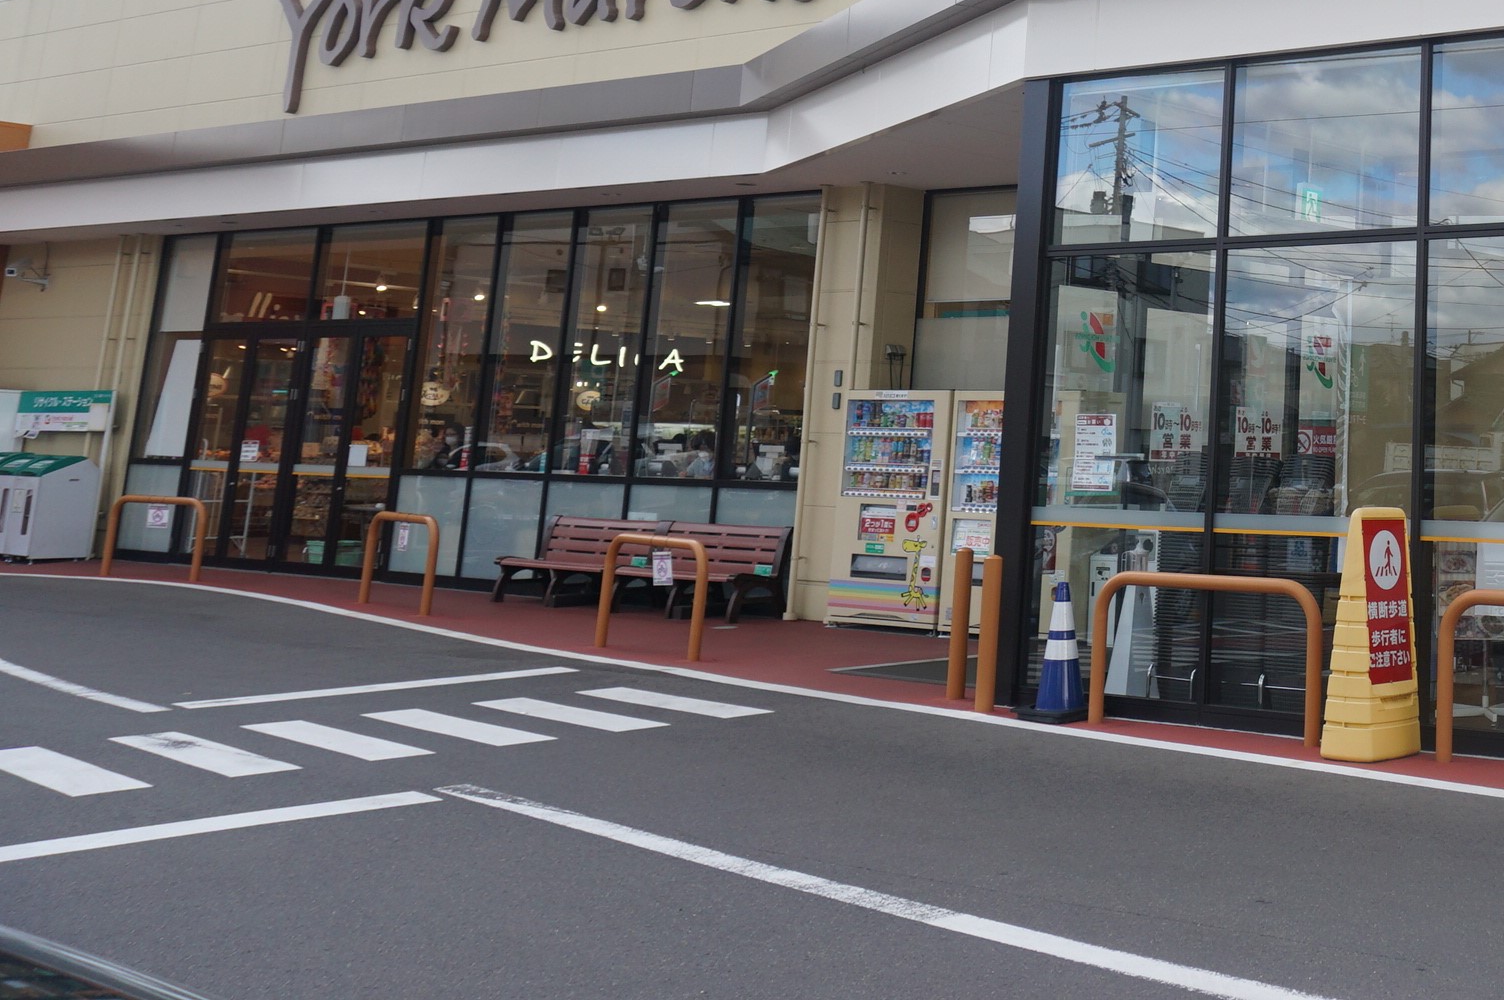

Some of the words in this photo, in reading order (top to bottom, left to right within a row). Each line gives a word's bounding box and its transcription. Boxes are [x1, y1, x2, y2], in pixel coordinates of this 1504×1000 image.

[529, 340, 685, 372] DELIA
[1162, 433, 1192, 449] 営業
[1246, 436, 1272, 451] 営業
[1368, 600, 1408, 620] 横断歩道
[1371, 628, 1407, 647] 歩行者に
[1369, 649, 1411, 668] ご注意下さい
